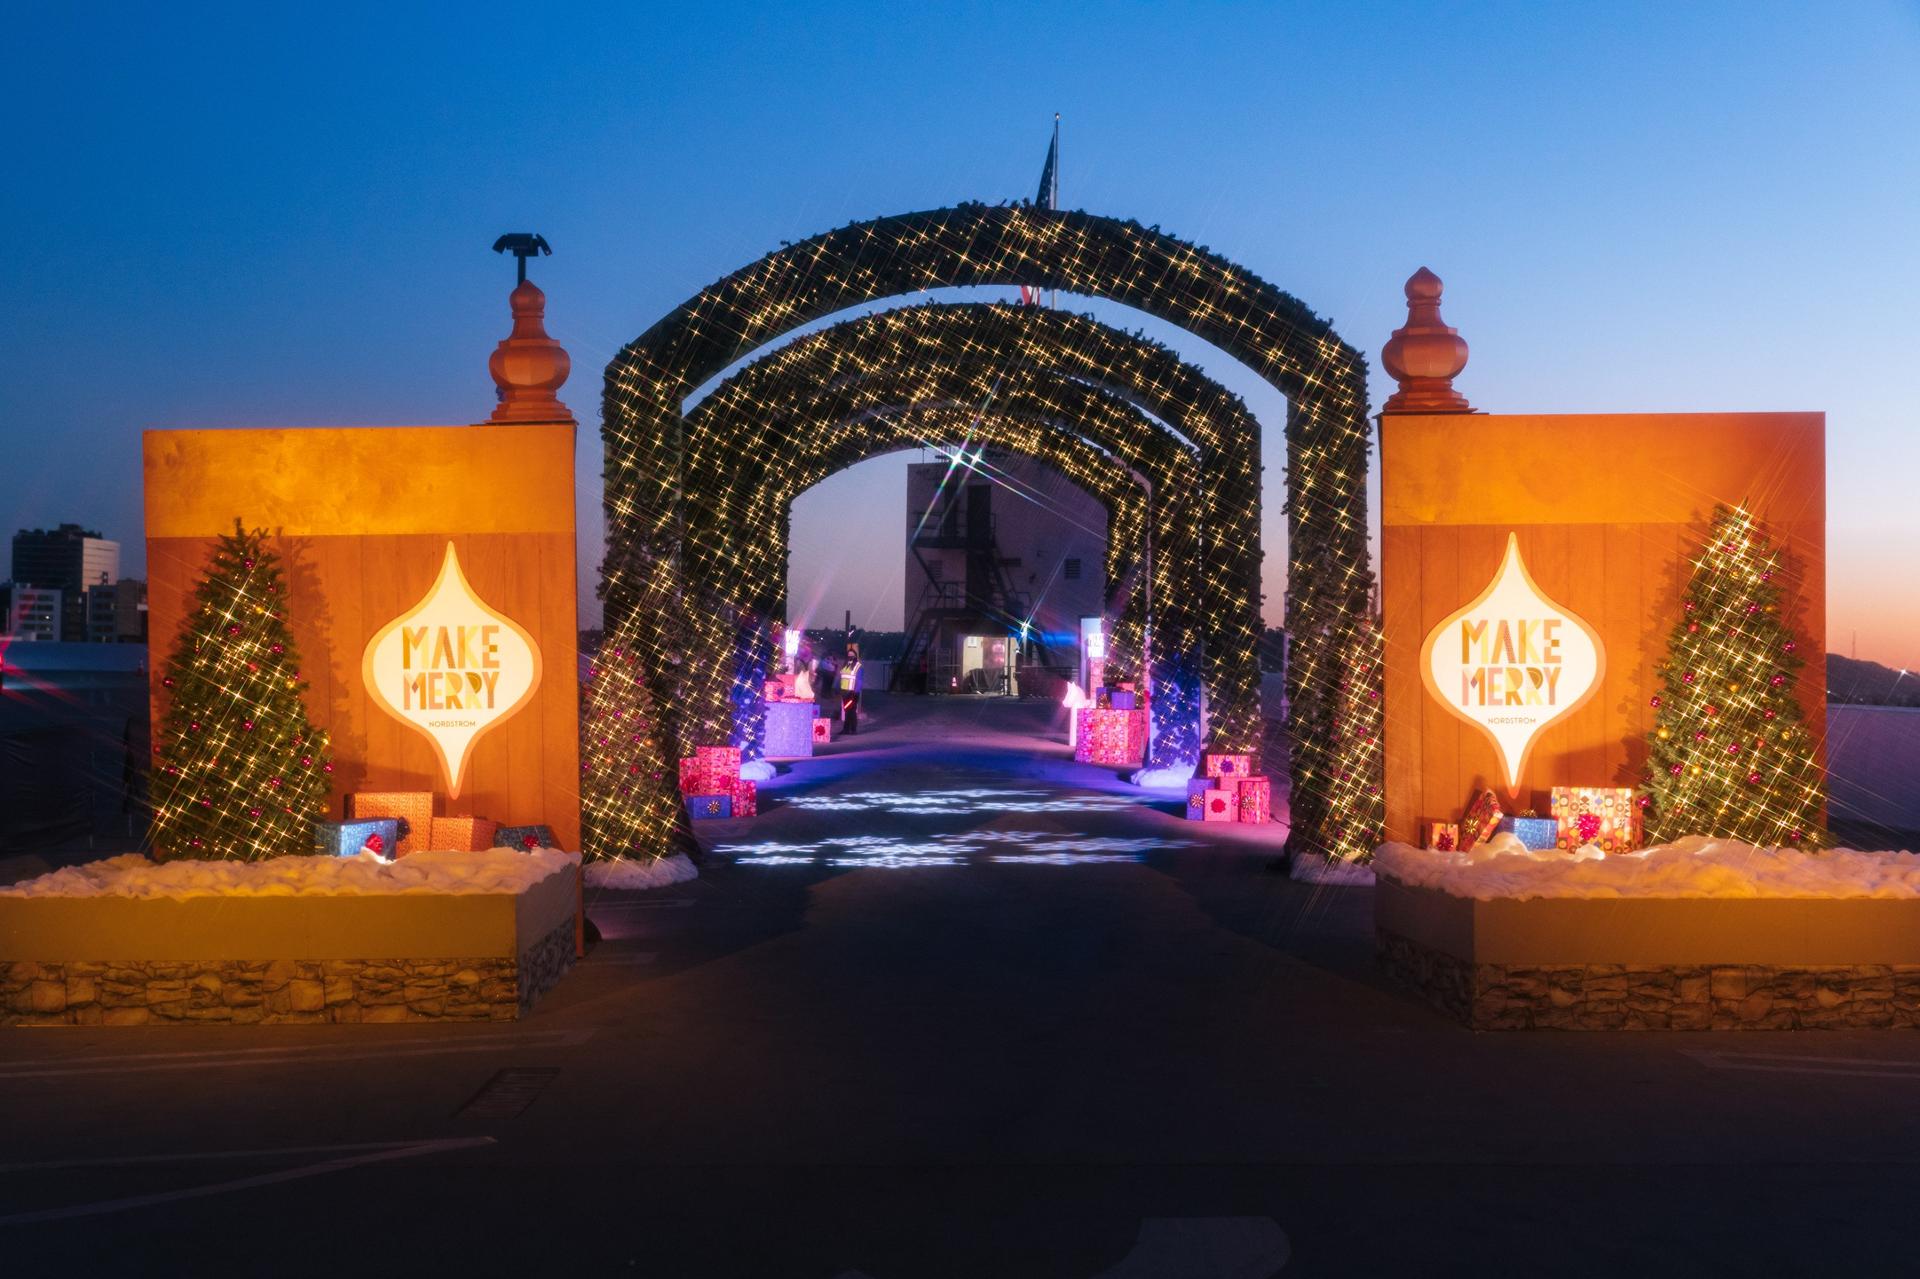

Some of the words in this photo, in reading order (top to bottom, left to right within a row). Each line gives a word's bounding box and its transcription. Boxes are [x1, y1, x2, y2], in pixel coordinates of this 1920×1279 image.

[402, 625, 500, 669] MAKE
[1461, 619, 1562, 664] MAKE
[403, 671, 500, 710] MERRY
[1461, 667, 1562, 706] MERRY
[428, 720, 476, 728] NORDSTROM
[1488, 717, 1536, 725] NORDSTROM
